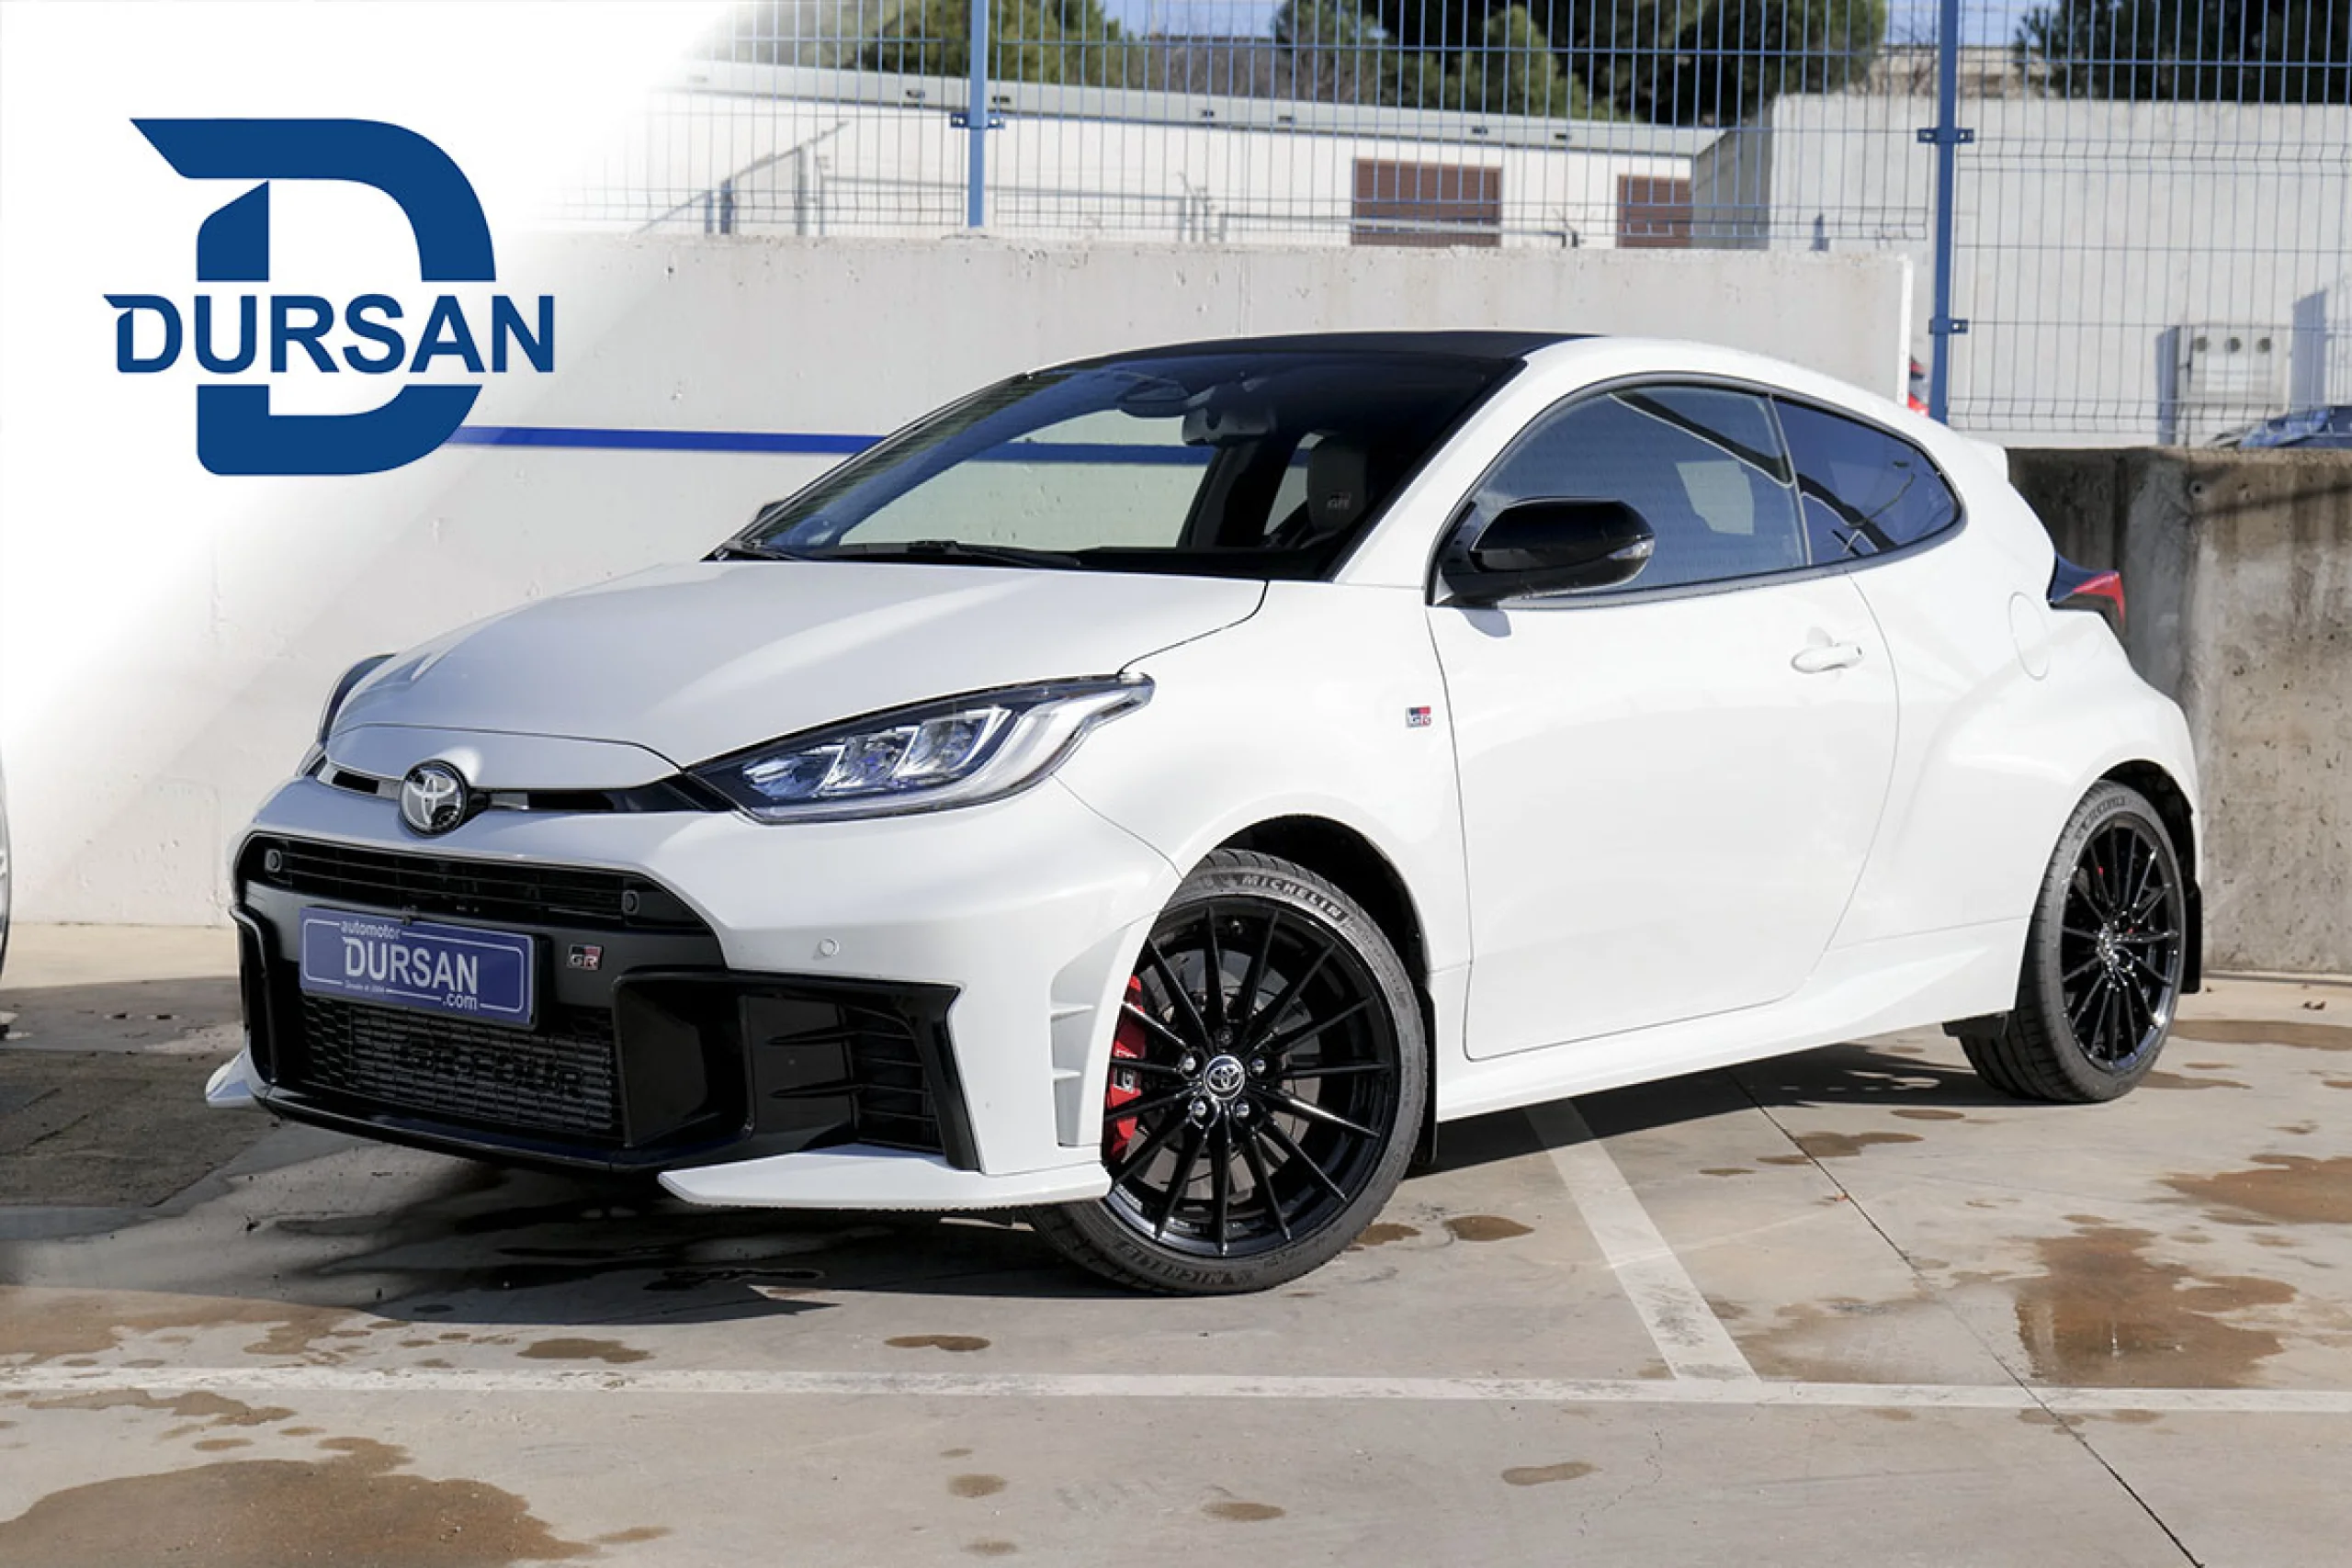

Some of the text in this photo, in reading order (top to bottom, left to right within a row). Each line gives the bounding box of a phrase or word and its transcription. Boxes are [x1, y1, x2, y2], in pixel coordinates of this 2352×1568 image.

[1241, 875, 1345, 921] MICHELIN
[340, 920, 401, 939] automotor
[343, 937, 478, 995] DURSAN
[443, 993, 478, 1010] .com
